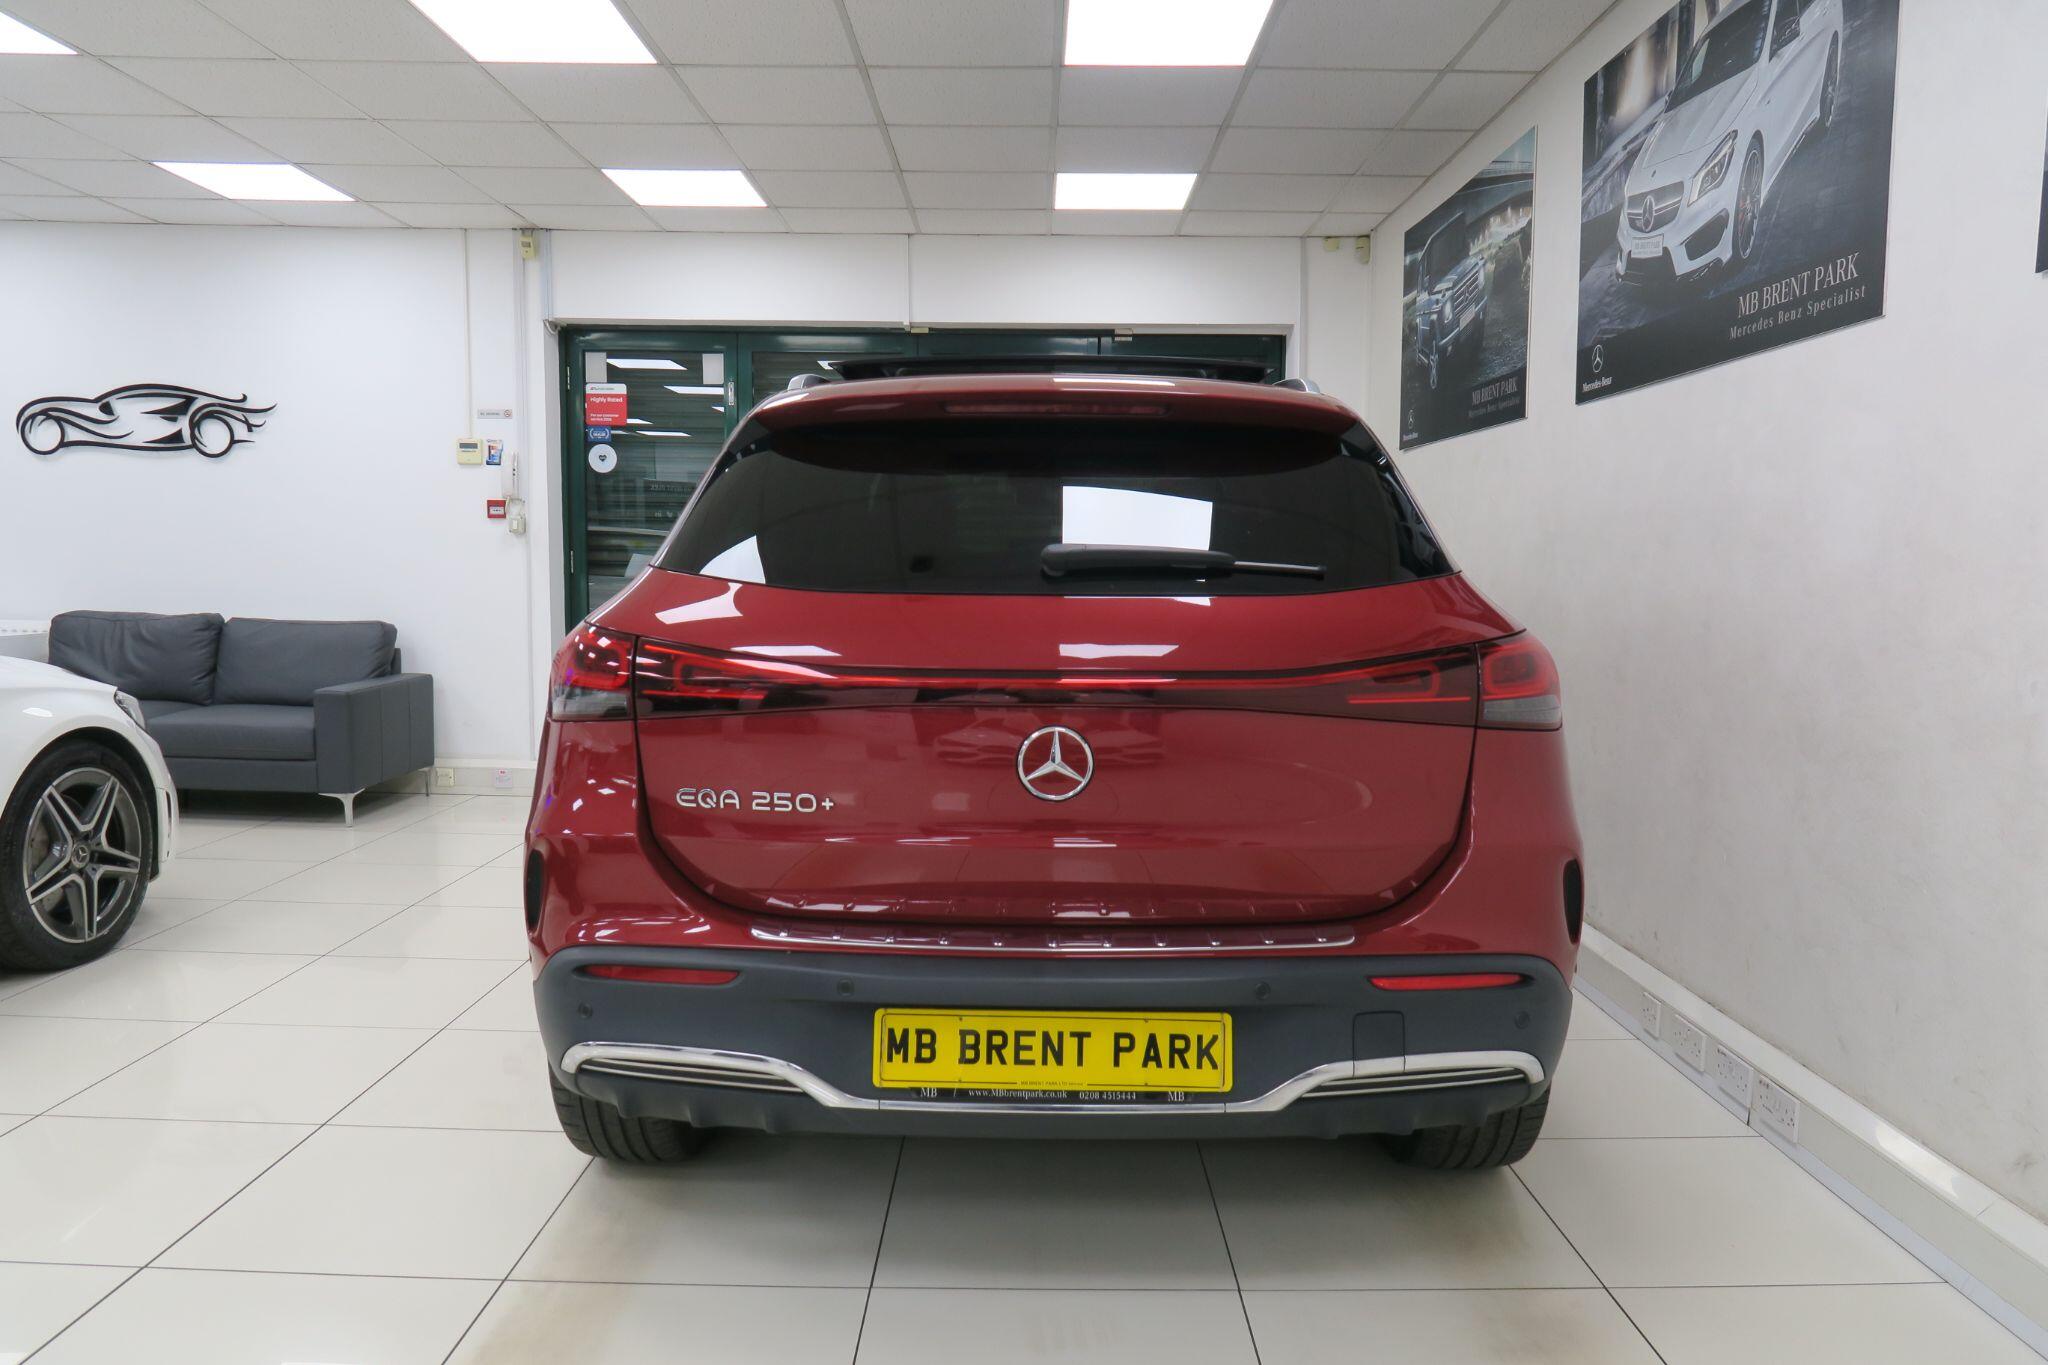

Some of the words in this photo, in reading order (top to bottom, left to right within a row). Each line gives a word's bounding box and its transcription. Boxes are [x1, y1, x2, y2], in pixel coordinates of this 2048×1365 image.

[1738, 291, 1759, 318] MB
[1761, 271, 1810, 310] BRENT
[1813, 252, 1859, 292] PARK
[1730, 316, 1774, 340] Mercedes
[1778, 308, 1802, 324] Benz
[1806, 285, 1866, 316] Specialist
[1481, 382, 1500, 402] BRENT
[1500, 376, 1518, 397] PARK
[675, 787, 740, 810] EQA
[752, 791, 835, 813] 250+
[886, 1027, 937, 1064] MB
[958, 1029, 1092, 1067] BRENT
[1113, 1032, 1219, 1070] PARK
[920, 1086, 937, 1098] MB
[968, 1088, 1068, 1100] www.MBbrentpark.co.uk
[1079, 1091, 1100, 1101] 0208
[1102, 1092, 1136, 1101] 4515444
[1167, 1091, 1185, 1102] MB
